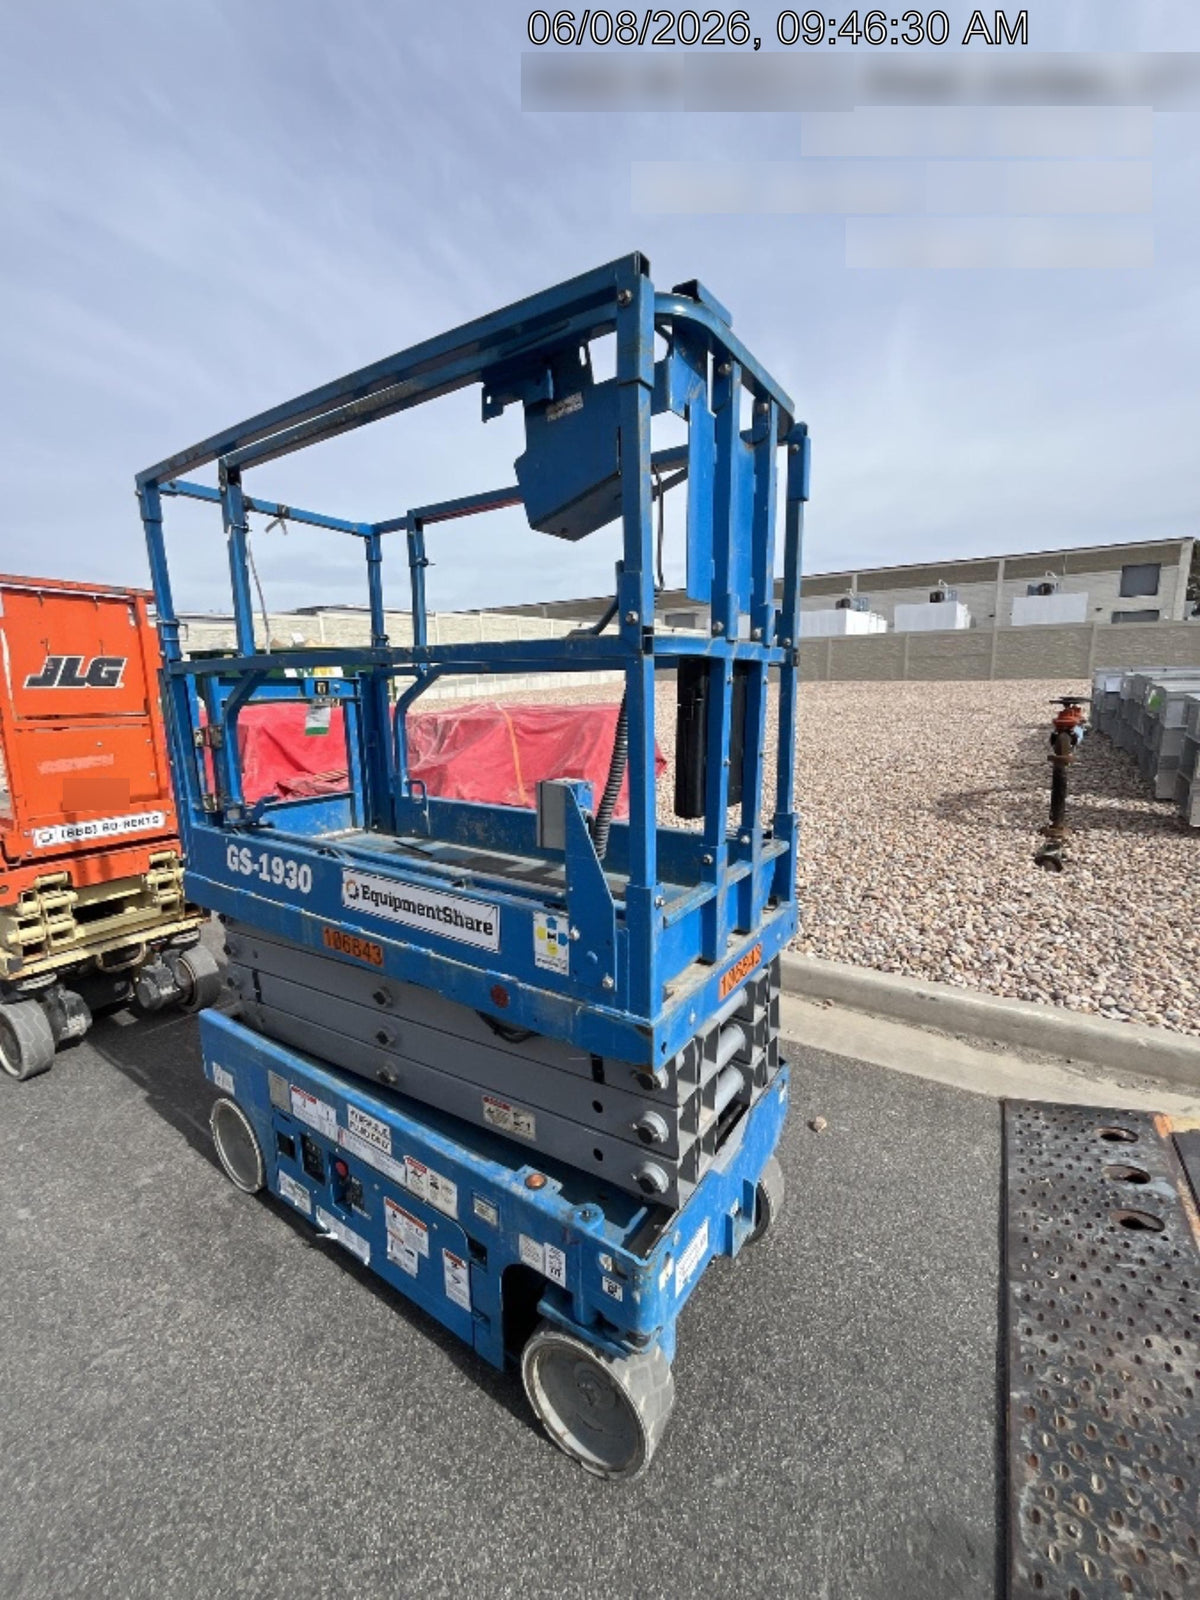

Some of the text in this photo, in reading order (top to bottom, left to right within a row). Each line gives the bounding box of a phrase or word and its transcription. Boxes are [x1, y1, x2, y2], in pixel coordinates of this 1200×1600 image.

[23, 655, 127, 689] JLG
[226, 844, 312, 894] GS-1930
[361, 884, 494, 936] EquipmentShare
